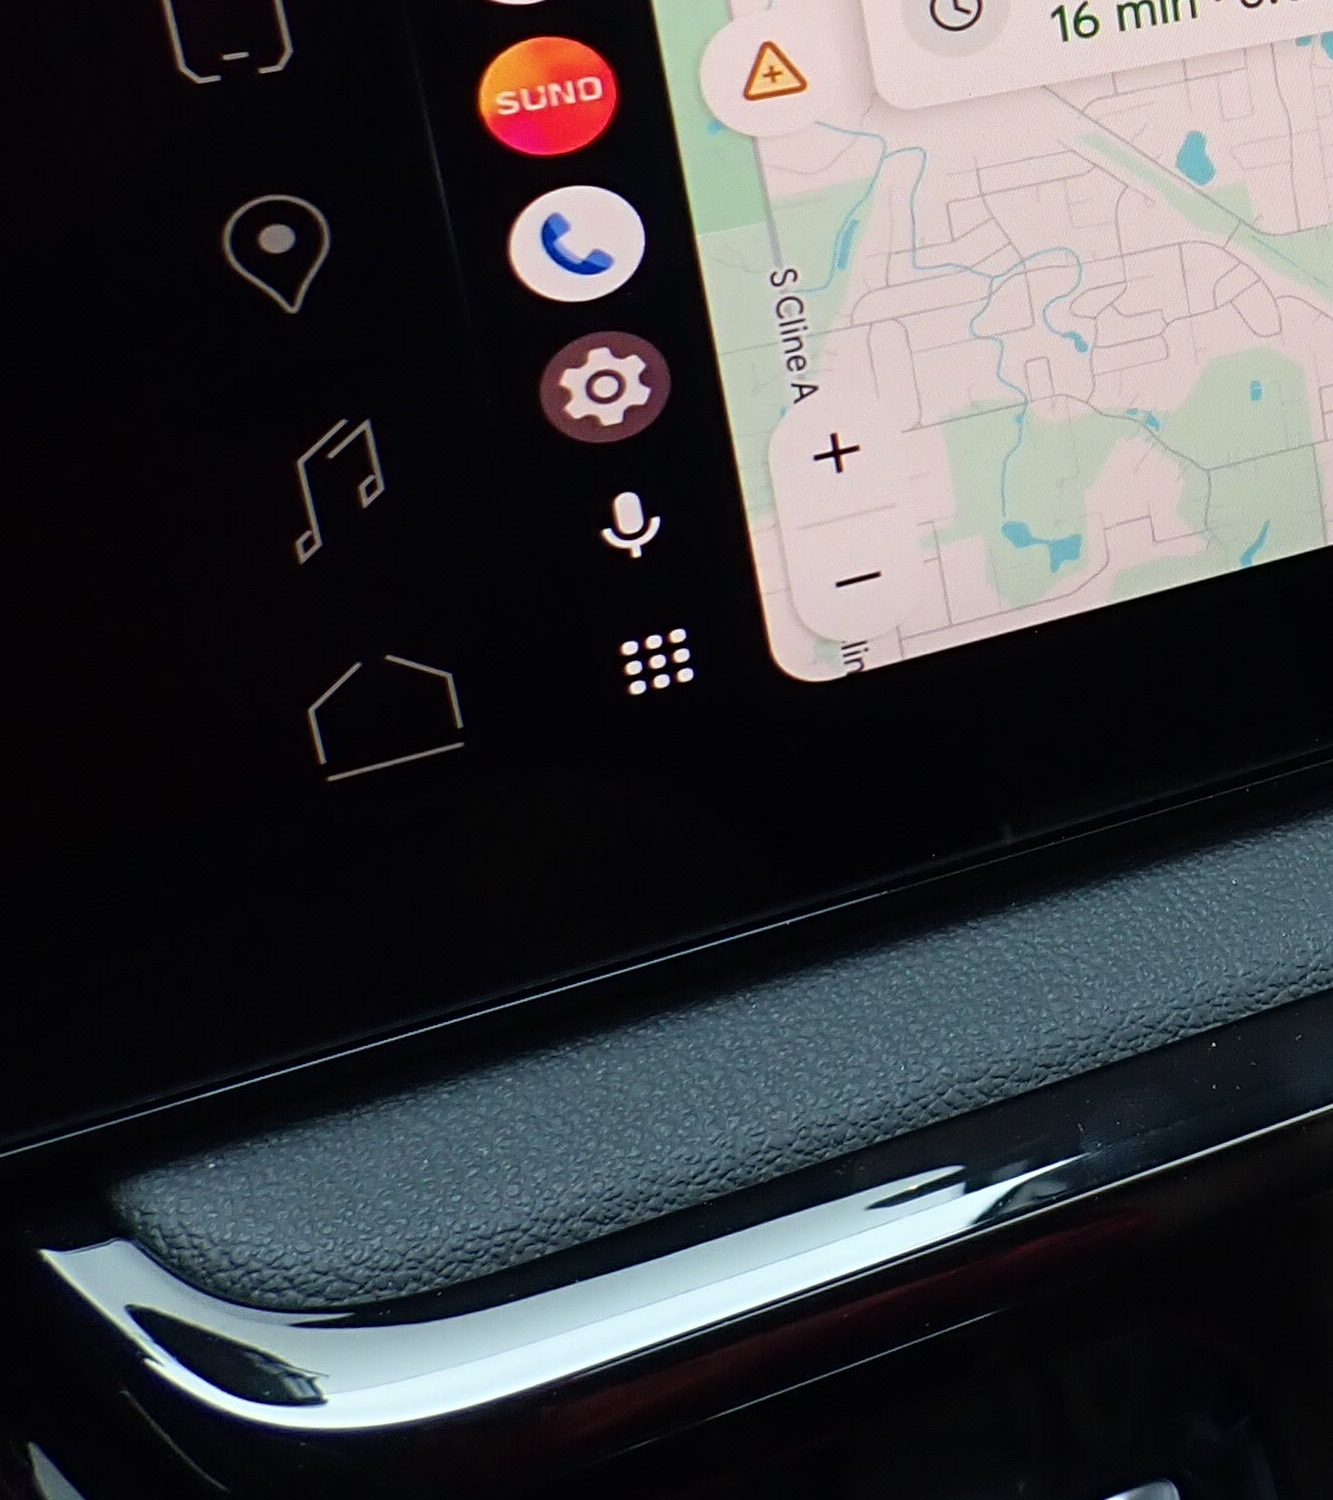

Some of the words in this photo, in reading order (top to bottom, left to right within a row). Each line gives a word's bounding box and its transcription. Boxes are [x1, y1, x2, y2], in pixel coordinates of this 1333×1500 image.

[1050, 1, 1100, 42] 16
[770, 268, 798, 287] S
[775, 296, 809, 373] Cline
